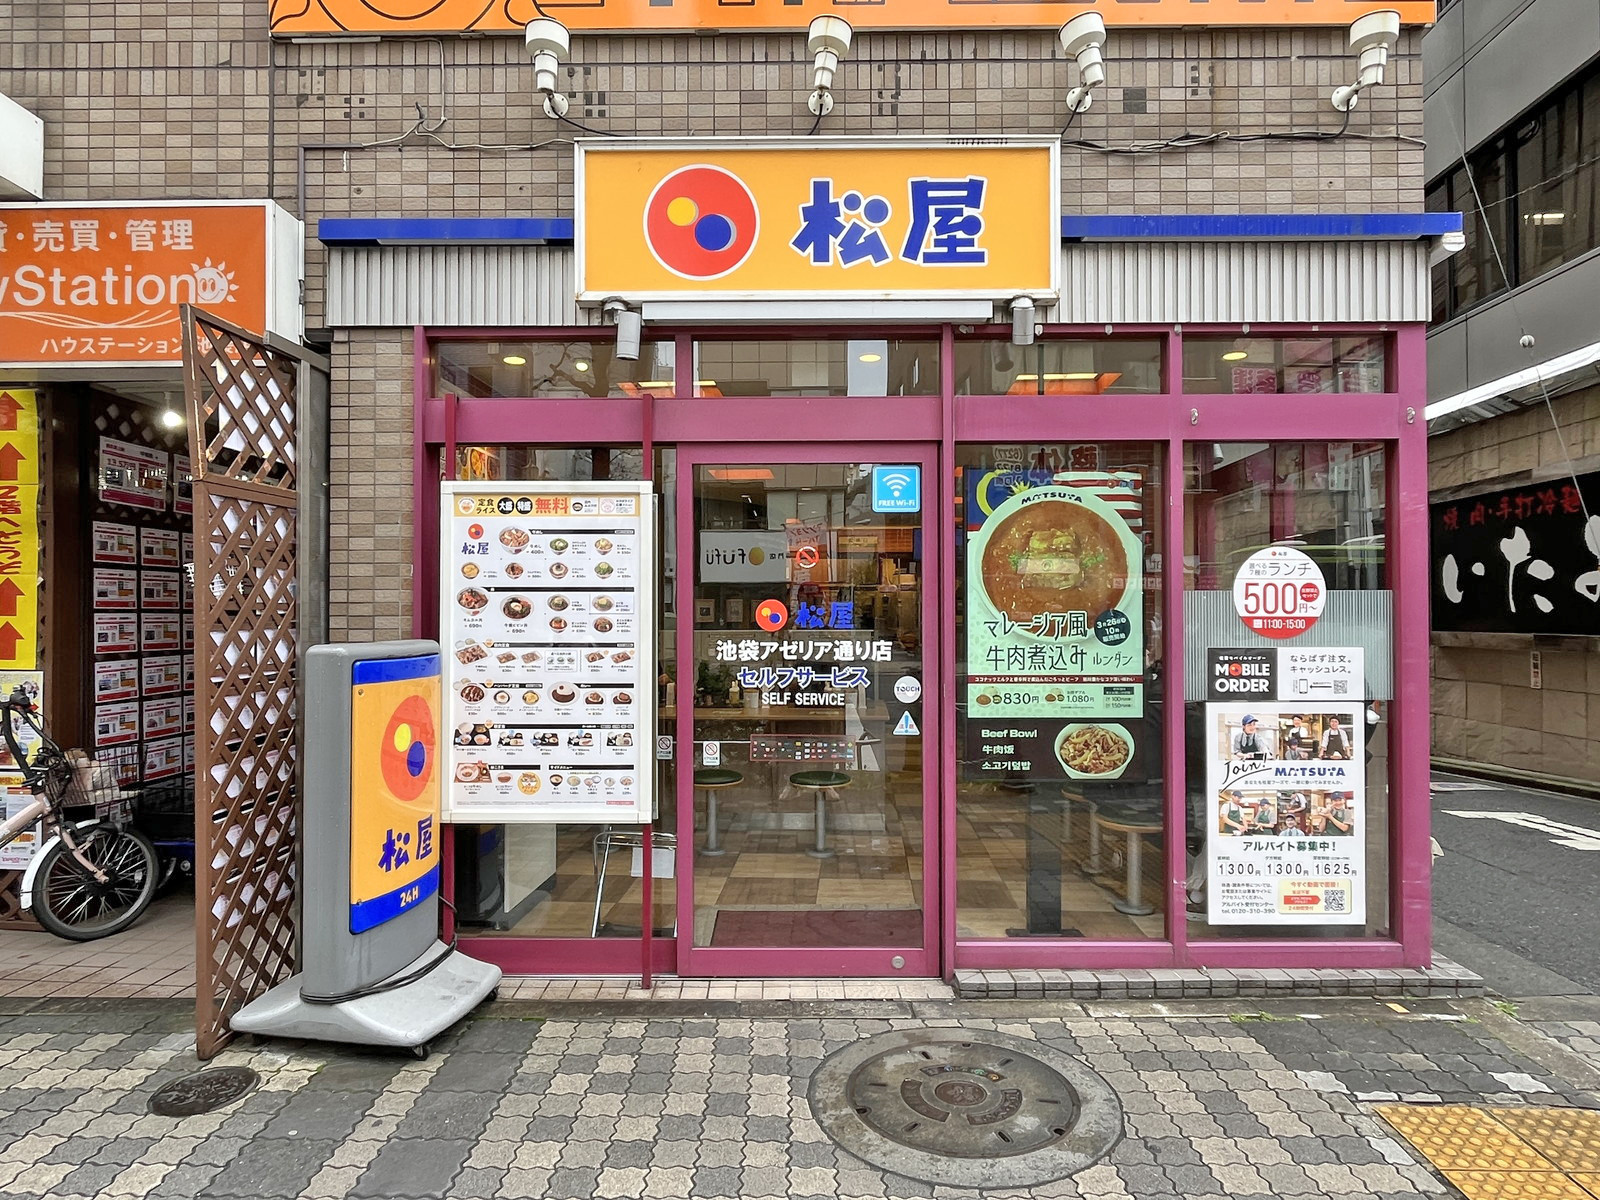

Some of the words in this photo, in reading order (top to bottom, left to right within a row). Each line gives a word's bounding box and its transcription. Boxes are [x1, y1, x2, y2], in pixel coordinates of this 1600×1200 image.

[790, 176, 987, 267] 松屋
[0, 219, 193, 252] ・売買・管理
[478, 498, 494, 507] 定食
[535, 497, 569, 514] 無料
[461, 542, 490, 555] 松屋
[1269, 562, 1312, 577] ランチ
[795, 602, 854, 629] 松屋
[983, 611, 1088, 641] マレーシア風
[716, 640, 893, 662] 池袋アゼリア通り店
[985, 645, 1088, 672] 牛肉煮込み
[1093, 651, 1134, 669] ルンダン
[737, 666, 871, 690] セルフサービス
[1215, 663, 1271, 676] MOBILE
[1290, 665, 1351, 674] キャッシュレス。
[1215, 678, 1270, 693] ORDER
[761, 692, 791, 706] SELF
[794, 692, 845, 706] SERVICE
[1004, 692, 1040, 705] 830円
[981, 729, 1009, 738] Beef
[1009, 729, 1038, 738] Bowl
[378, 813, 433, 873] 松屋
[1315, 863, 1357, 877] 1625円
[399, 885, 420, 908] 24H
